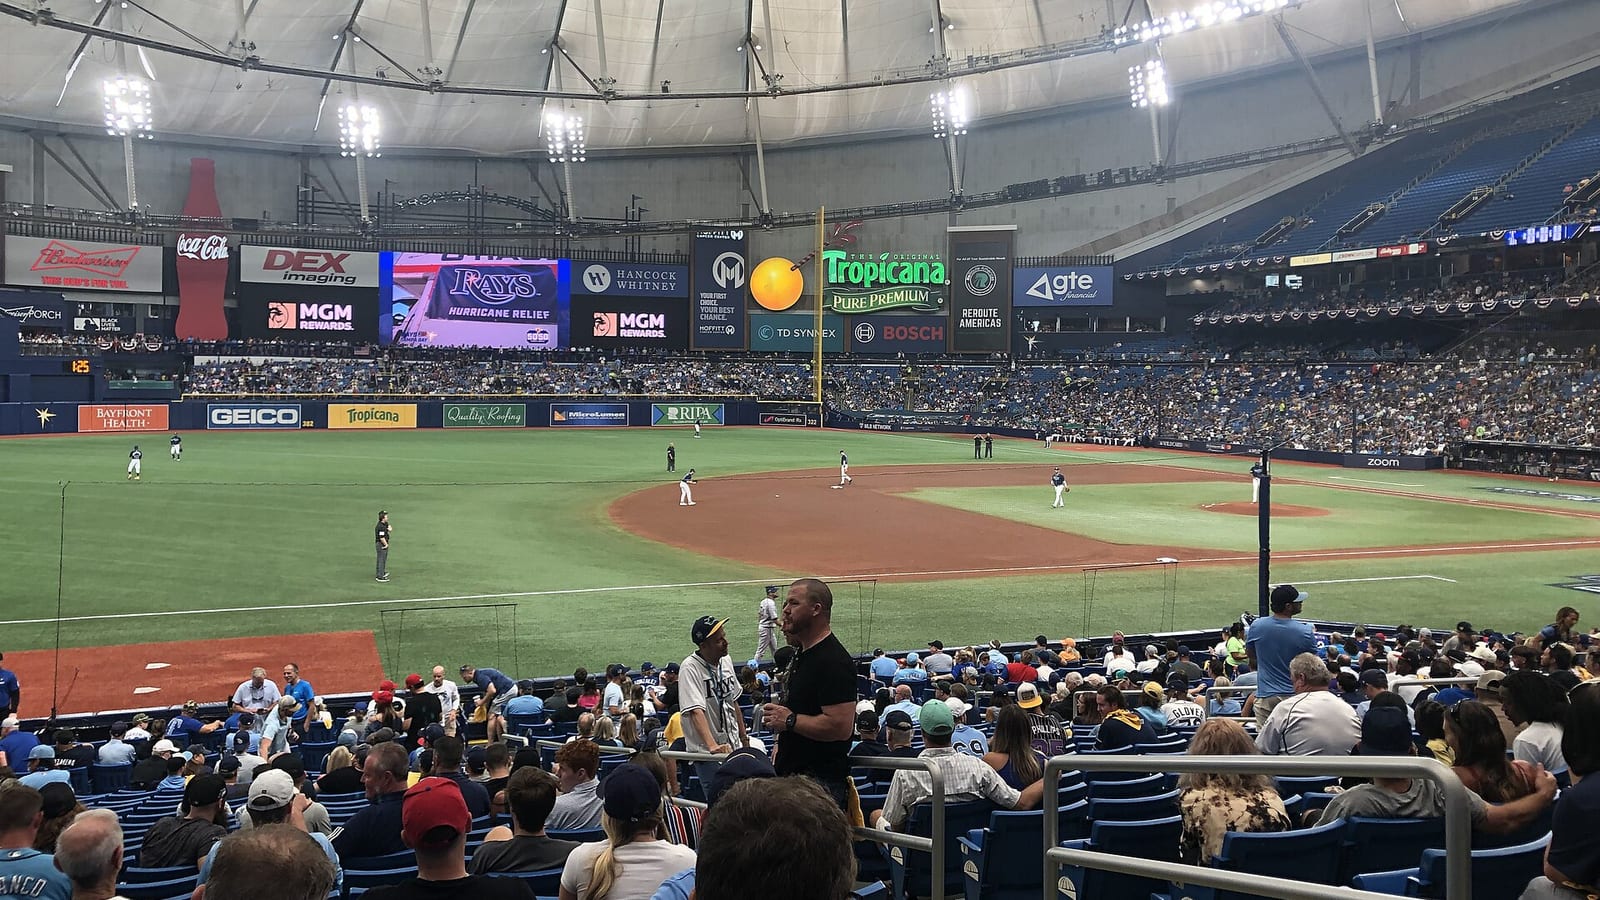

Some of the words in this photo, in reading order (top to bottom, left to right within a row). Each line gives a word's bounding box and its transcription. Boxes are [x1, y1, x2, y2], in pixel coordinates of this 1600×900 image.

[177, 233, 229, 260] Coca-Cola
[41, 248, 129, 268] Budweiser
[263, 250, 350, 273] DEX
[617, 270, 676, 280] HANCOCK
[823, 250, 945, 287] Tropicana
[283, 271, 356, 284] imaging
[1053, 271, 1093, 294] gte
[450, 268, 536, 305] RAYS
[617, 281, 676, 290] WHITNEY
[833, 295, 866, 309] PURE
[869, 290, 929, 303] PREMIUM
[1060, 290, 1098, 301] financial
[29, 310, 61, 319] PORCH
[300, 304, 352, 320] MGM
[449, 307, 510, 318] HURRICANE
[512, 309, 550, 319] RELIEF
[962, 308, 998, 318] REROUTE
[620, 313, 665, 328] MGM
[959, 318, 1002, 328] AMERICAS
[777, 329, 791, 338] TD
[883, 326, 943, 340] BOSCH
[97, 409, 152, 418] BAYFRONT
[211, 409, 298, 424] GEICO
[347, 407, 399, 423] Tropicana
[447, 407, 485, 424] Quality
[487, 407, 521, 423] Roofing
[680, 407, 711, 420] RIPA
[103, 419, 146, 428] HEALTH
[1367, 458, 1400, 466] zoom
